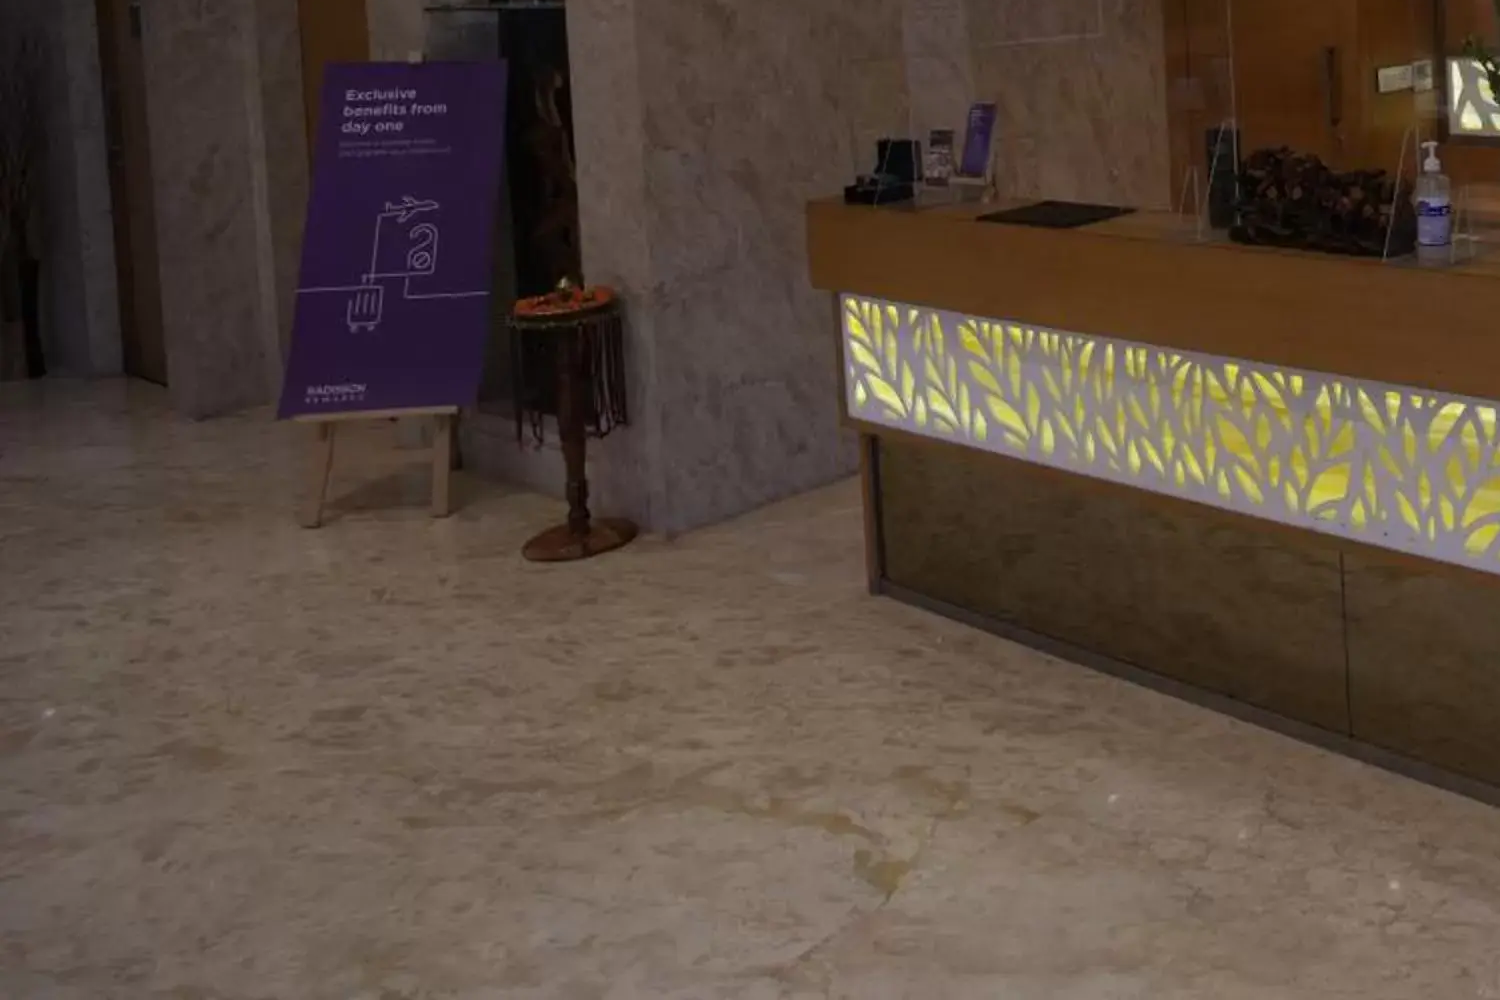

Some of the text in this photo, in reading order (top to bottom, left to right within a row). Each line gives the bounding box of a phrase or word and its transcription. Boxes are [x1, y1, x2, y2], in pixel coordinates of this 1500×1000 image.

[345, 87, 417, 101] Exclusive
[342, 103, 448, 117] benefits from
[341, 120, 404, 136] day one
